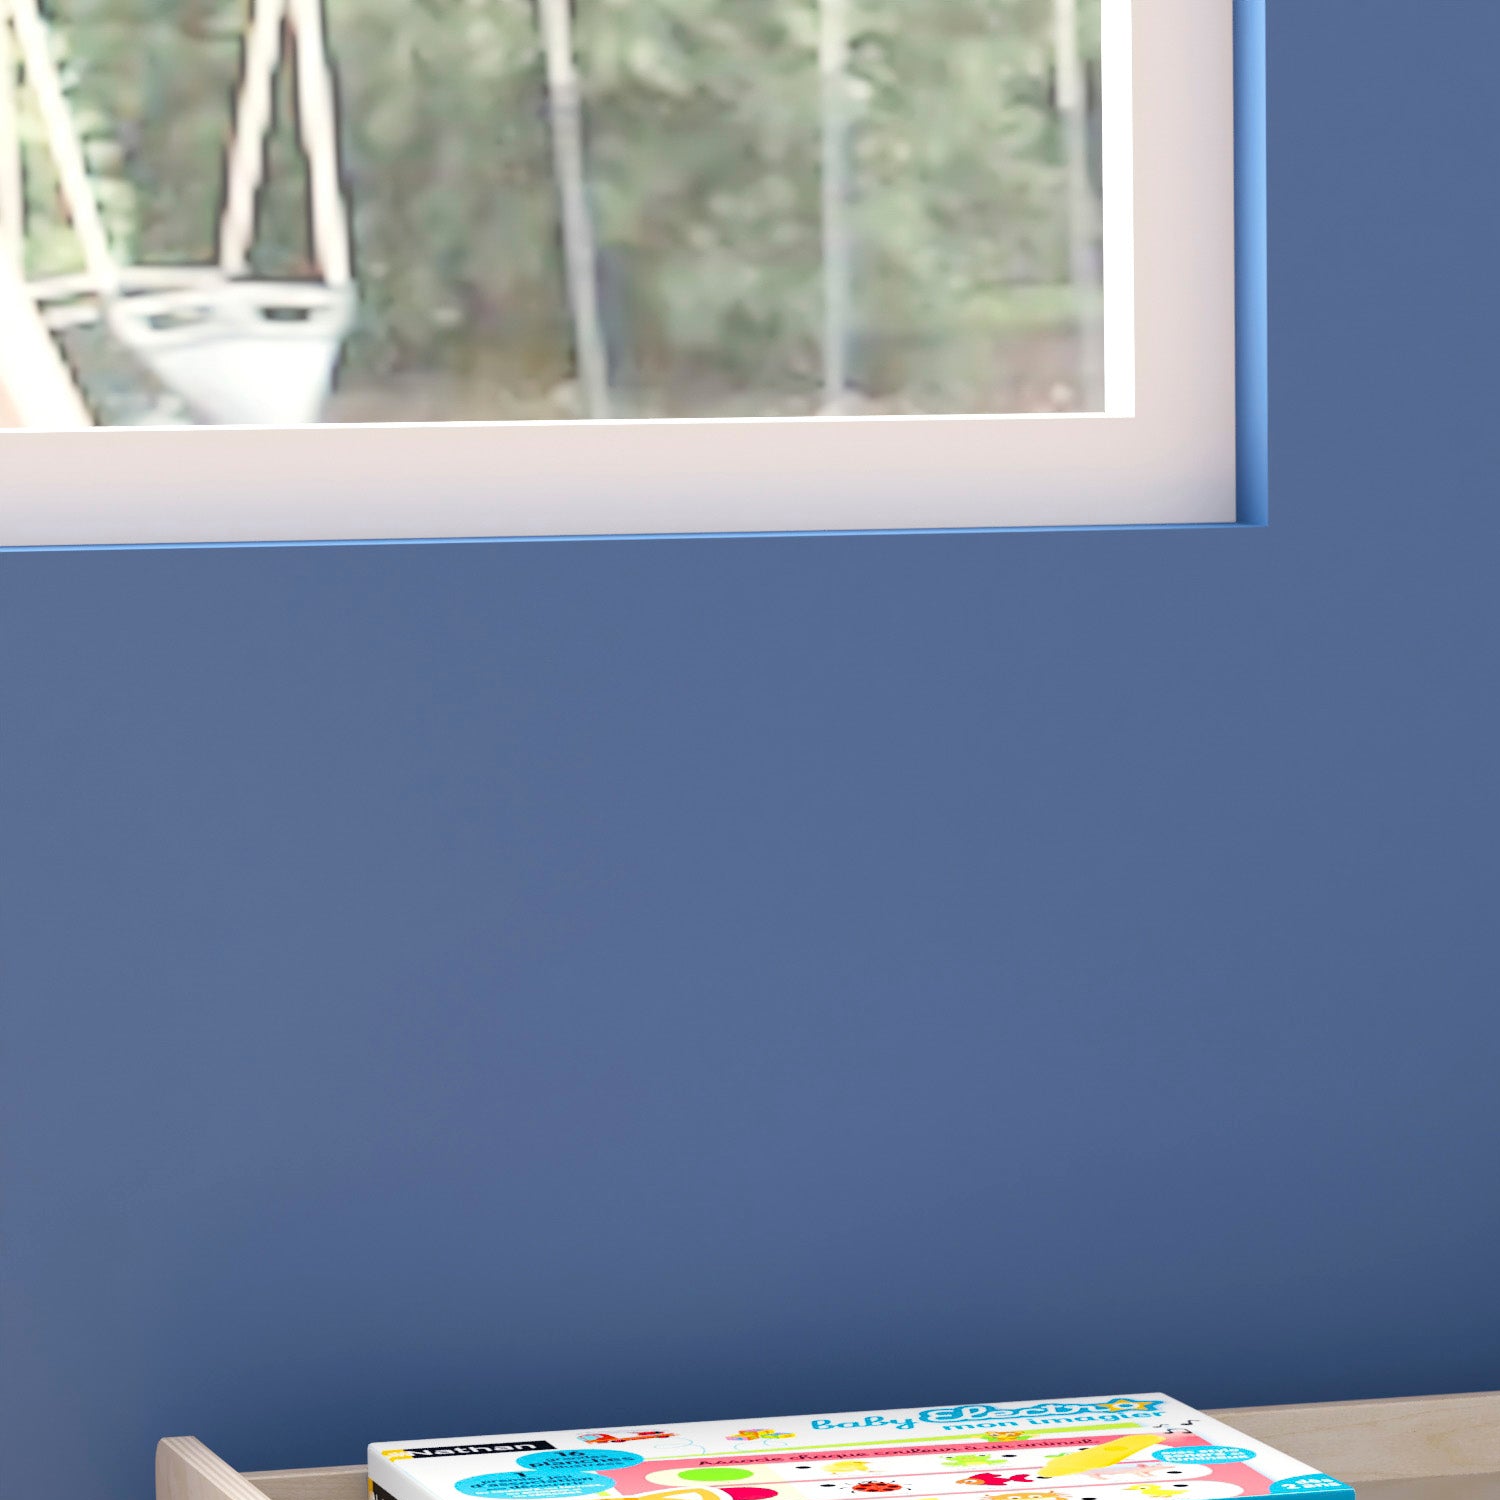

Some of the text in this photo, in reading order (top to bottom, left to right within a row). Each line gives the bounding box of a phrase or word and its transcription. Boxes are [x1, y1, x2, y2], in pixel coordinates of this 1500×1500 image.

[810, 1397, 1163, 1430] baby Electro
[942, 1410, 1164, 1431] mon imagier
[405, 1443, 538, 1457] Nathan
